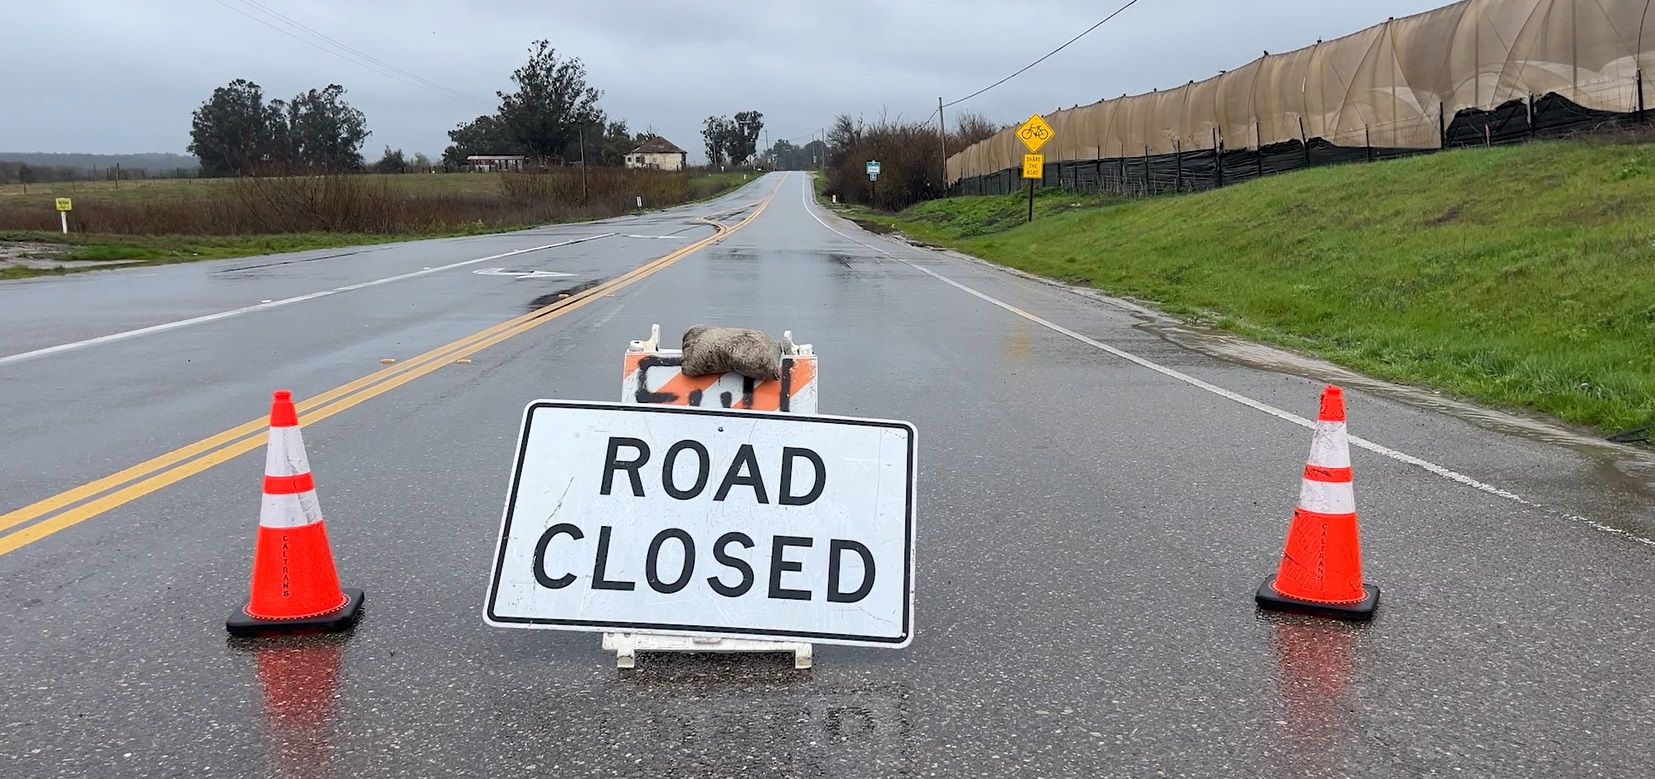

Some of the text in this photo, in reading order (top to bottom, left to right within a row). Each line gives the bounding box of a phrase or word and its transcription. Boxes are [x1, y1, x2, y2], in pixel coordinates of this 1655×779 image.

[600, 436, 826, 506] ROAD
[532, 523, 876, 603] CLOSED
[1317, 523, 1327, 581] CALTRANS
